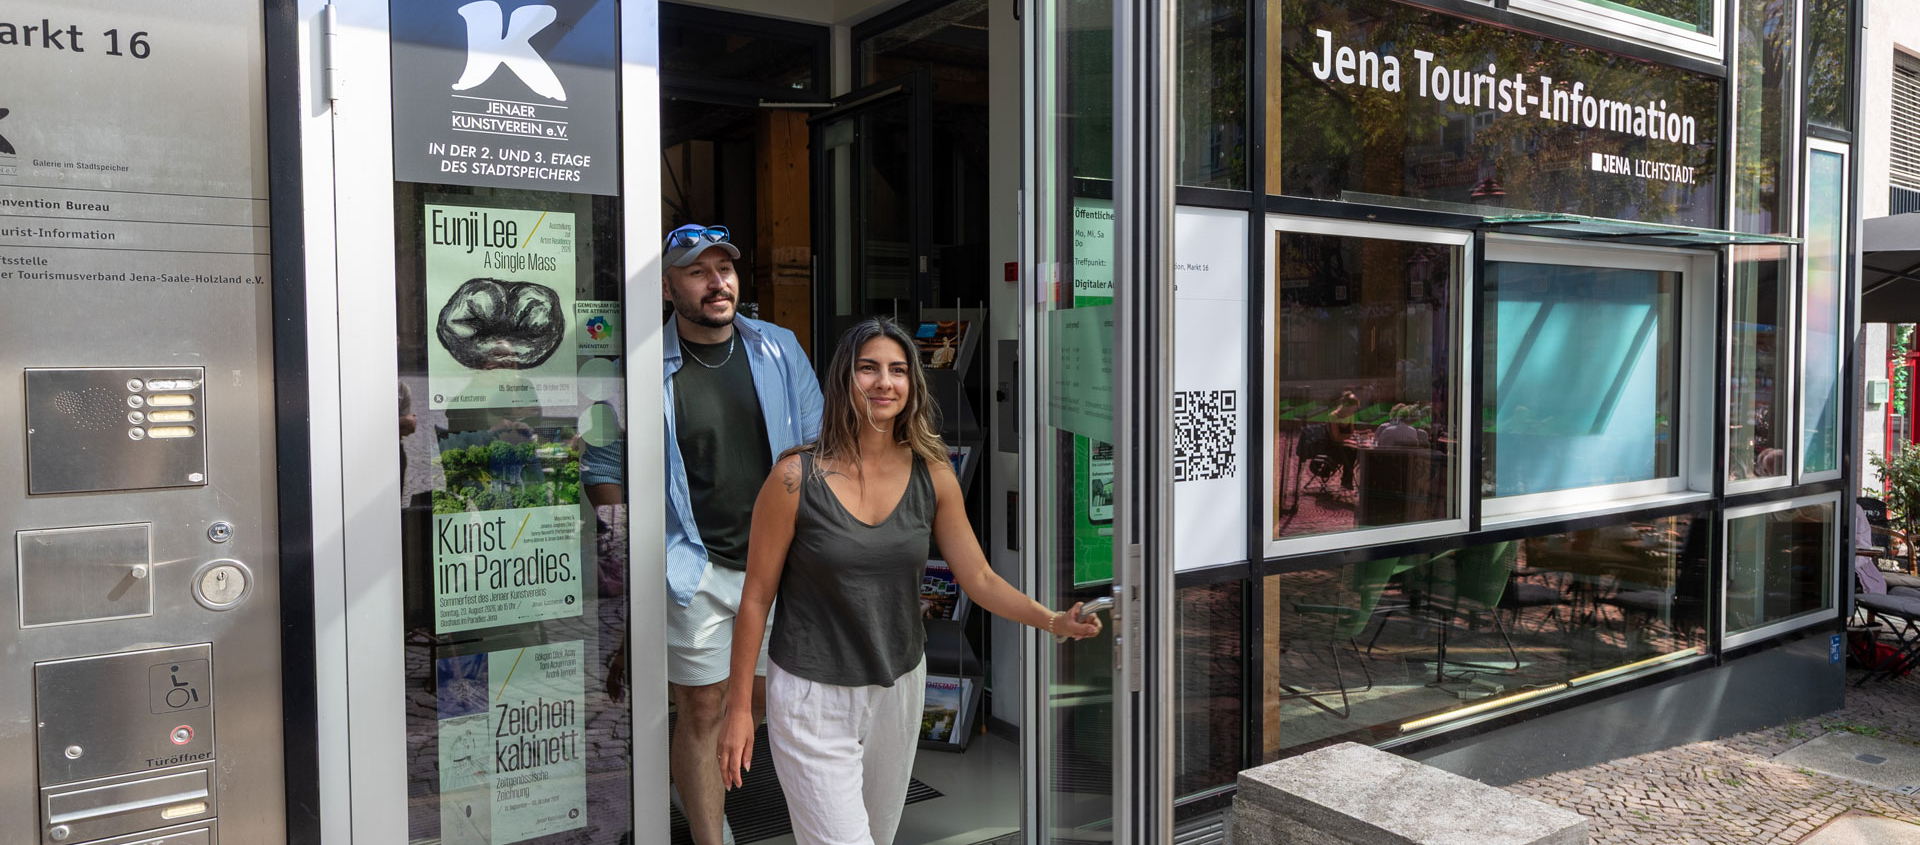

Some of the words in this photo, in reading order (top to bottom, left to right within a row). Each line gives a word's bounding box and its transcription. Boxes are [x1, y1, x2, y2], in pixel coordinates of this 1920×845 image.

[103, 29, 151, 59] 16
[452, 0, 566, 101] K
[1312, 28, 1401, 94] Jena
[1413, 49, 1696, 145] Tourist-Information
[486, 102, 535, 118] JENAER
[452, 115, 542, 135] KUNSTVEREIN
[546, 125, 567, 138] e.V.
[428, 143, 445, 156] IN
[450, 144, 477, 158] DER
[481, 147, 493, 160] 2.
[499, 149, 530, 162] UND
[534, 151, 546, 164] 3.
[551, 153, 591, 167] ETAGE
[33, 159, 61, 168] Galerie
[64, 161, 74, 169] im
[76, 161, 129, 172] Stadtspeicher
[441, 160, 467, 173] DES
[471, 162, 581, 182] STADTSPEICHERS
[1603, 153, 1631, 176] JENA
[1635, 160, 1696, 185] LICHTSTADT.
[0, 199, 60, 209] nvention
[66, 201, 110, 212] Bureau
[1075, 206, 1115, 221] Öffentliche
[1, 227, 115, 240] urist-Information
[432, 209, 478, 254] Eunji
[483, 212, 518, 249] Lee
[1075, 229, 1086, 238] Mo,
[1087, 229, 1096, 238] Mi,
[1097, 230, 1104, 239] Sa
[1075, 239, 1083, 247] Do
[484, 251, 492, 268] A
[494, 251, 525, 274] Single
[527, 253, 556, 271] Mass
[1075, 257, 1107, 267] Treffpunkt:
[18, 270, 126, 282] Tourismusverband
[129, 271, 242, 285] Jena-Saale-Holzland
[245, 275, 265, 285] e.V.
[1075, 279, 1107, 290] Digitaler
[438, 516, 506, 555] Kunst
[439, 557, 467, 595] im
[475, 548, 576, 591] Paradies.
[439, 594, 478, 608] Sommerfest
[478, 594, 489, 603] des
[490, 592, 509, 603] Jenaer
[510, 588, 547, 600] Kunstvereins
[467, 615, 487, 624] Paradies
[487, 614, 498, 622] Jena
[468, 607, 484, 615] August
[550, 659, 577, 669] Ackermann
[495, 697, 575, 738] Zeichen
[146, 751, 212, 768] Türöffner
[495, 729, 579, 774] kabinett
[496, 769, 549, 789] Zeitgenössische
[496, 787, 530, 802] Zeichnung
